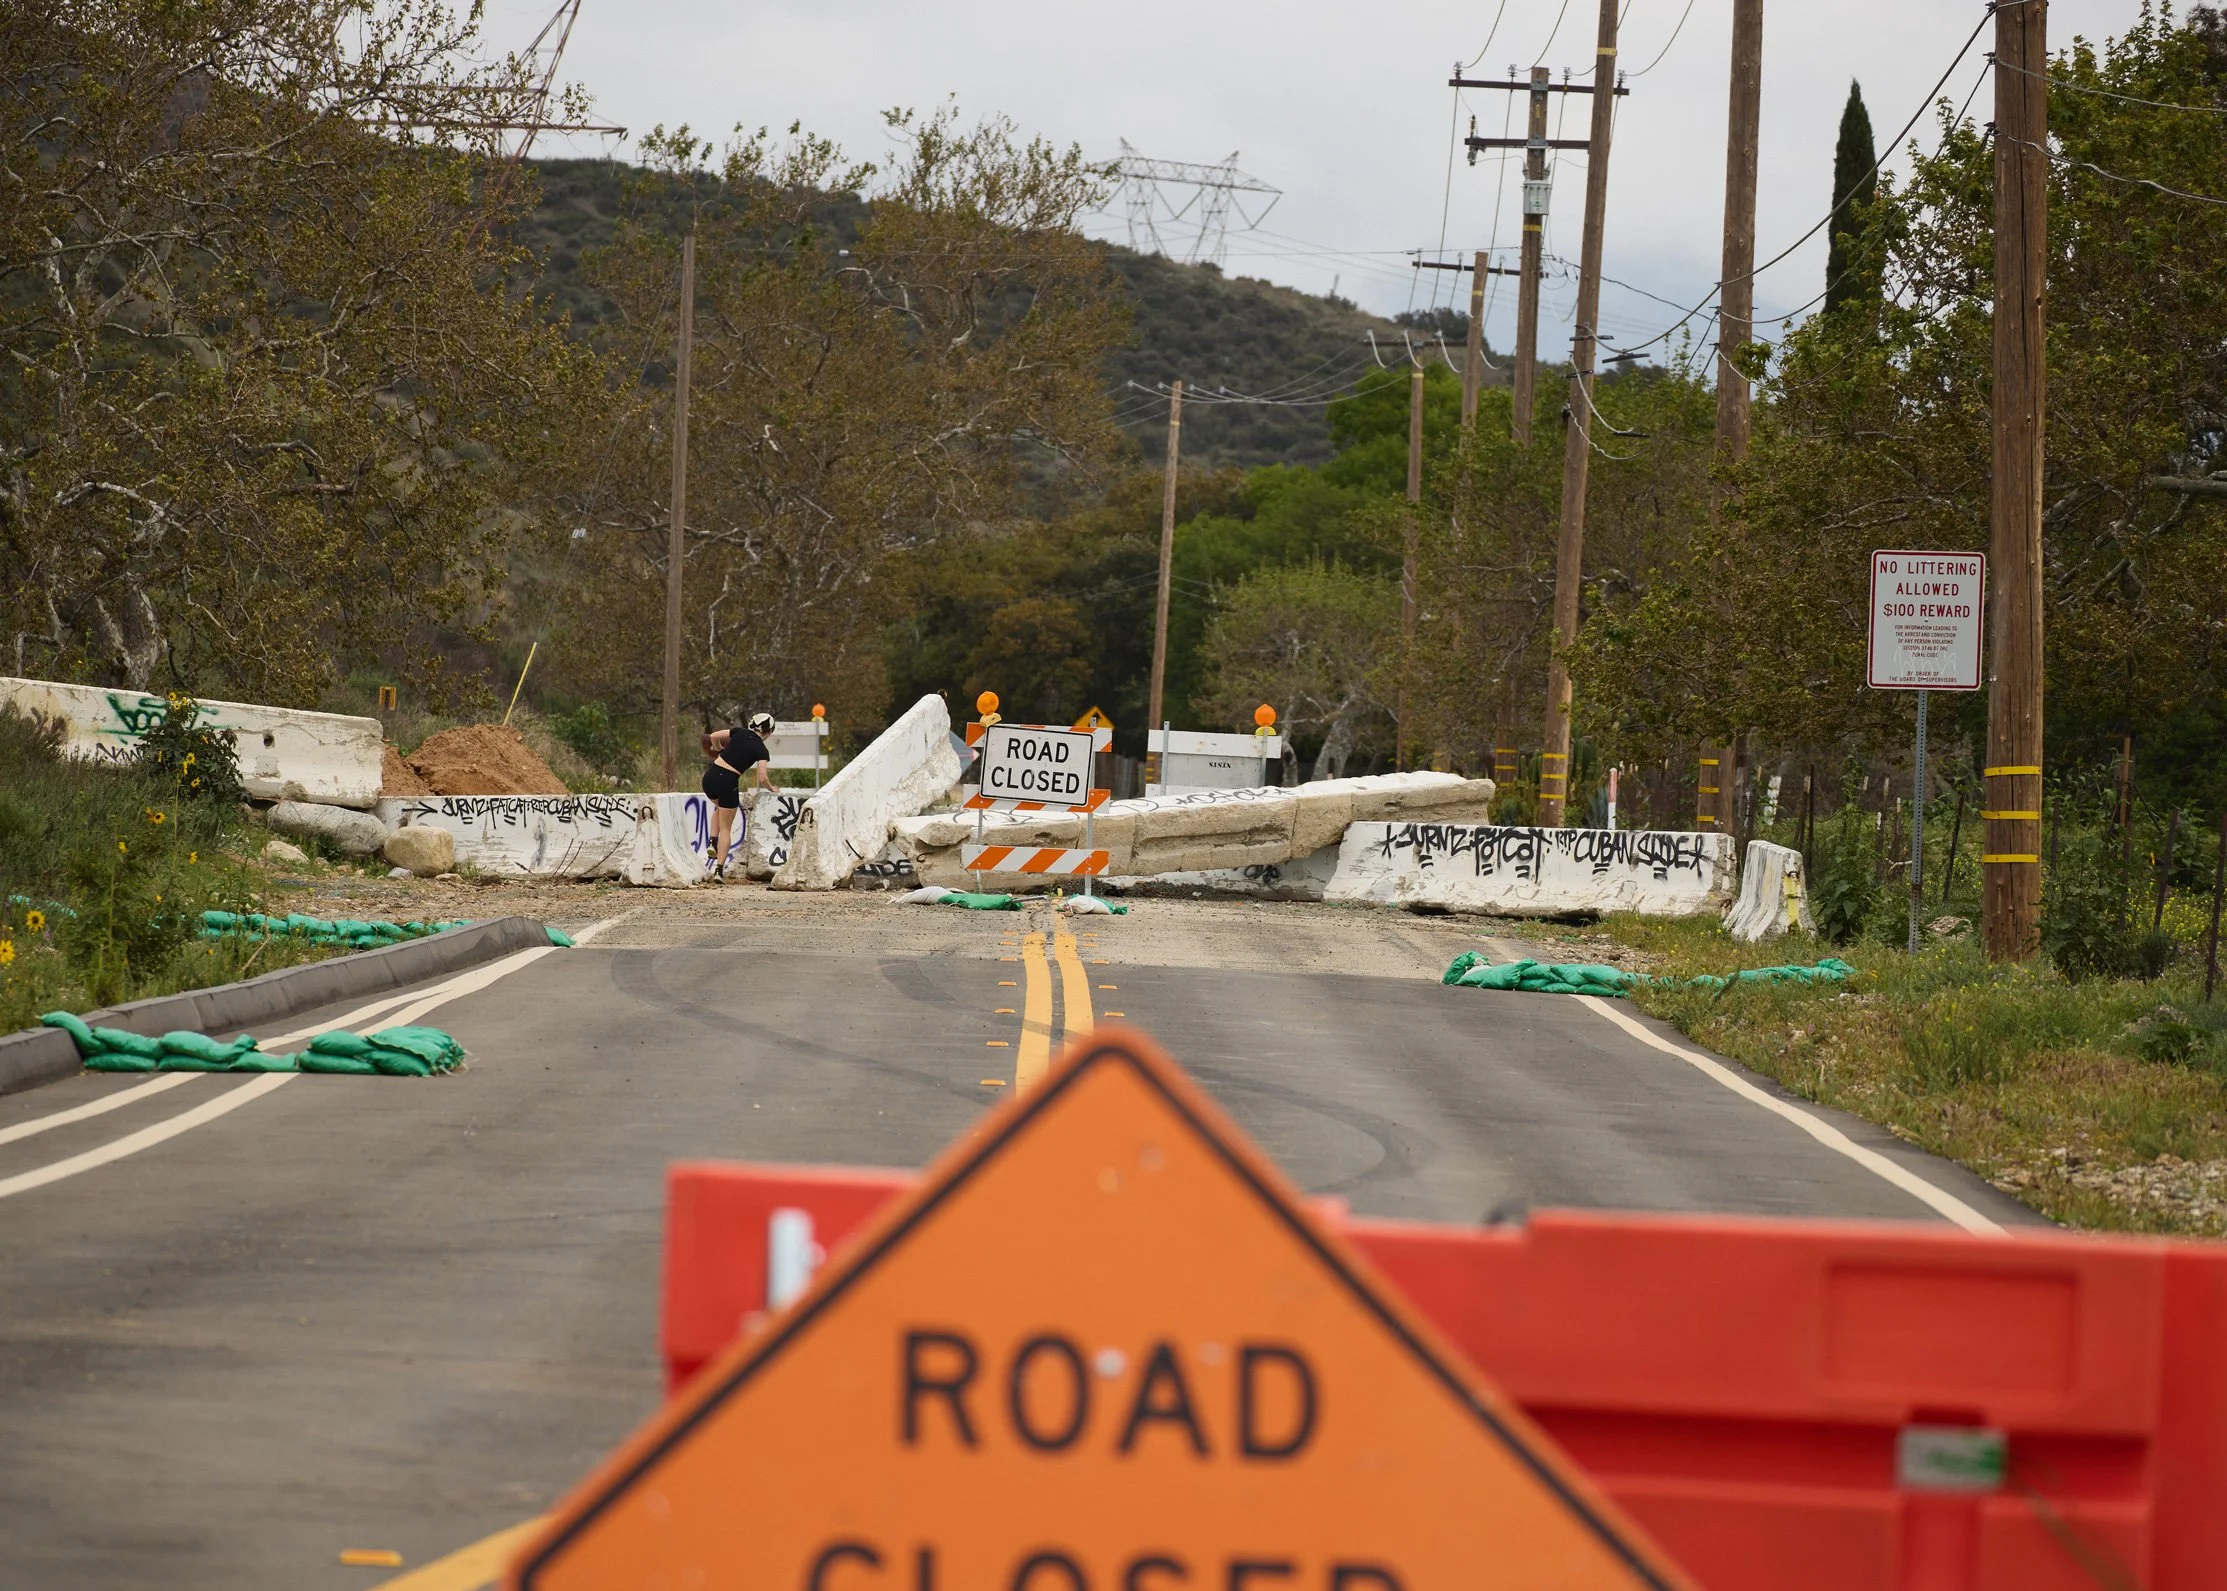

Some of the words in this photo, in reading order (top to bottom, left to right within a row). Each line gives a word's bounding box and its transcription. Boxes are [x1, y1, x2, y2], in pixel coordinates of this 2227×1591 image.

[1880, 561, 1898, 574] NO
[1907, 561, 1977, 576] LITTERING
[1896, 583, 1959, 596] ALLOWED
[1883, 603, 1915, 617] $100
[1920, 604, 1971, 618] REWARD
[1007, 738, 1069, 763] ROAD
[991, 766, 1080, 794] CLOSED
[902, 1329, 1322, 1460] ROAD
